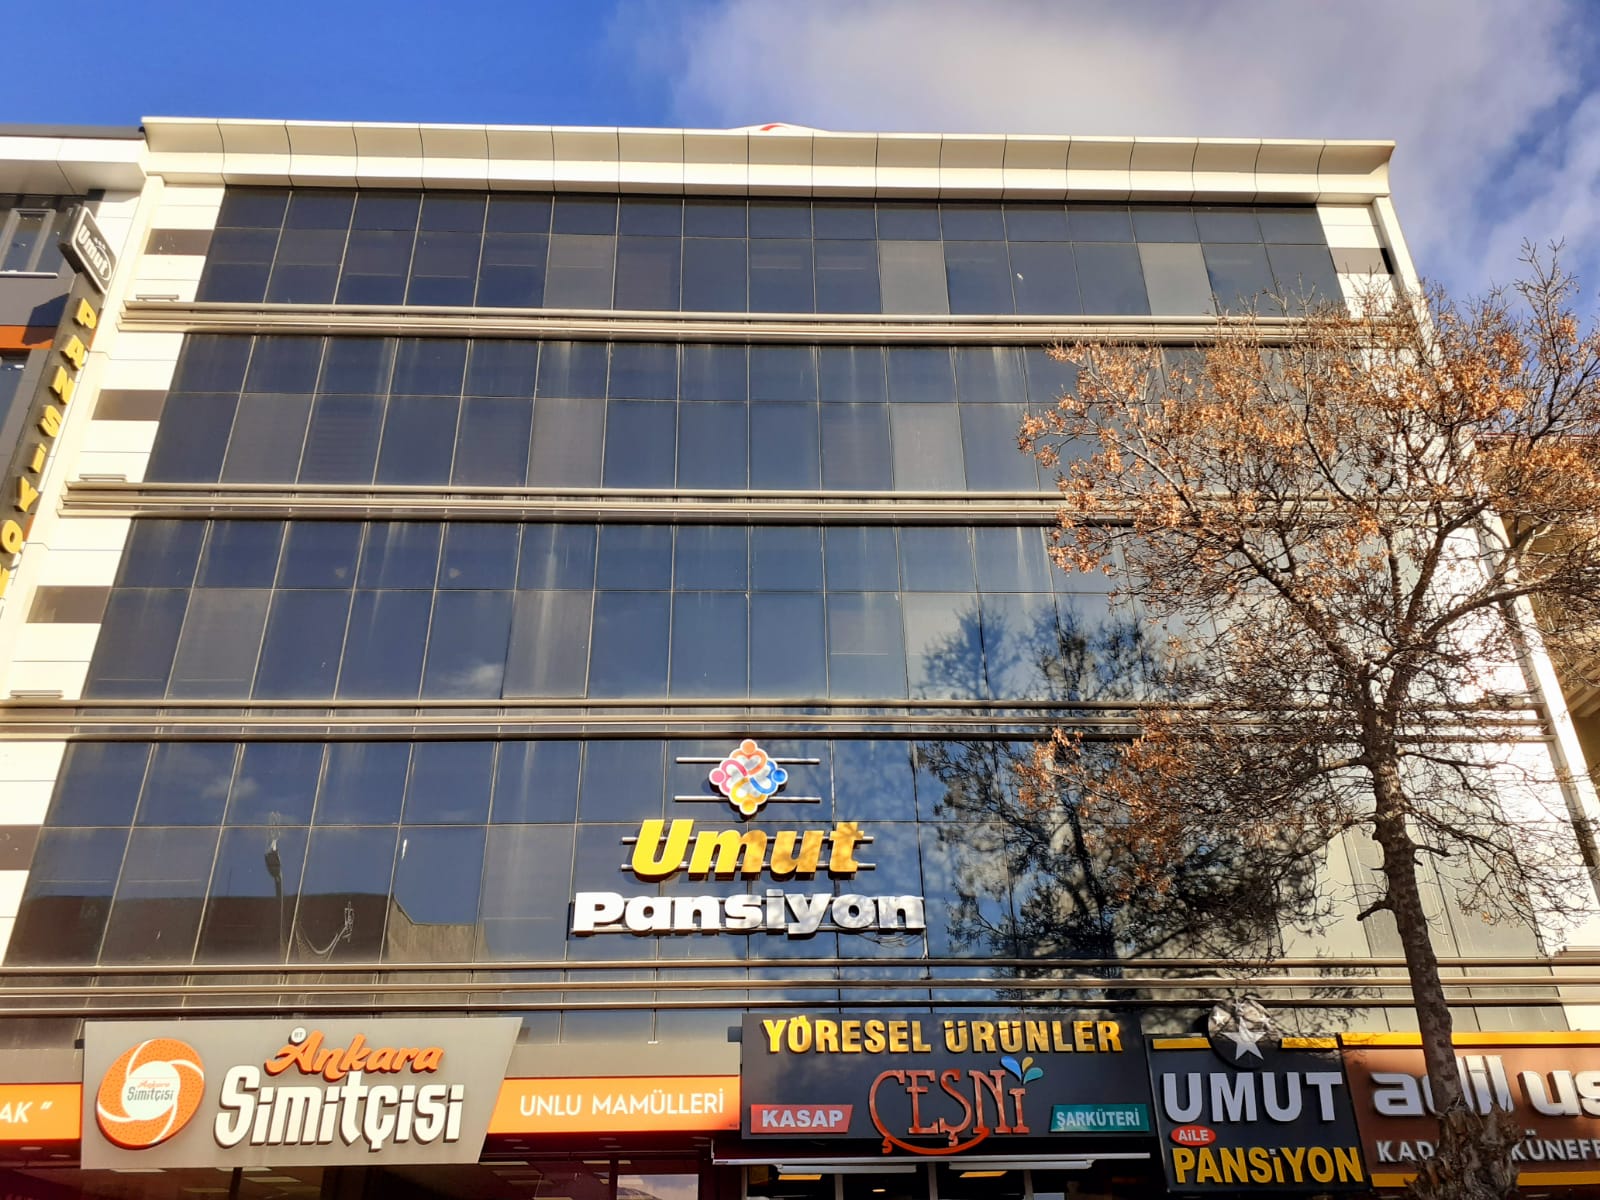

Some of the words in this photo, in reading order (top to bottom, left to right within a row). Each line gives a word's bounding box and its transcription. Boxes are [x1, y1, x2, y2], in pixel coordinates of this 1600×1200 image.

[78, 224, 108, 276] Umut
[631, 819, 864, 882] Umut
[572, 889, 926, 936] Pansiyon
[265, 1030, 444, 1080] Ankara
[762, 1015, 931, 1053] YÖRESEL
[944, 1020, 1123, 1053] ÜRÜNLER
[214, 1065, 464, 1151] Simitçisi
[520, 1095, 581, 1116] UNLU
[591, 1089, 724, 1115] MAMÜLLERİ
[762, 1109, 844, 1128] KASAP
[1056, 1106, 1141, 1130] ŞARKÜTERİ
[1163, 1071, 1342, 1122] UMUT
